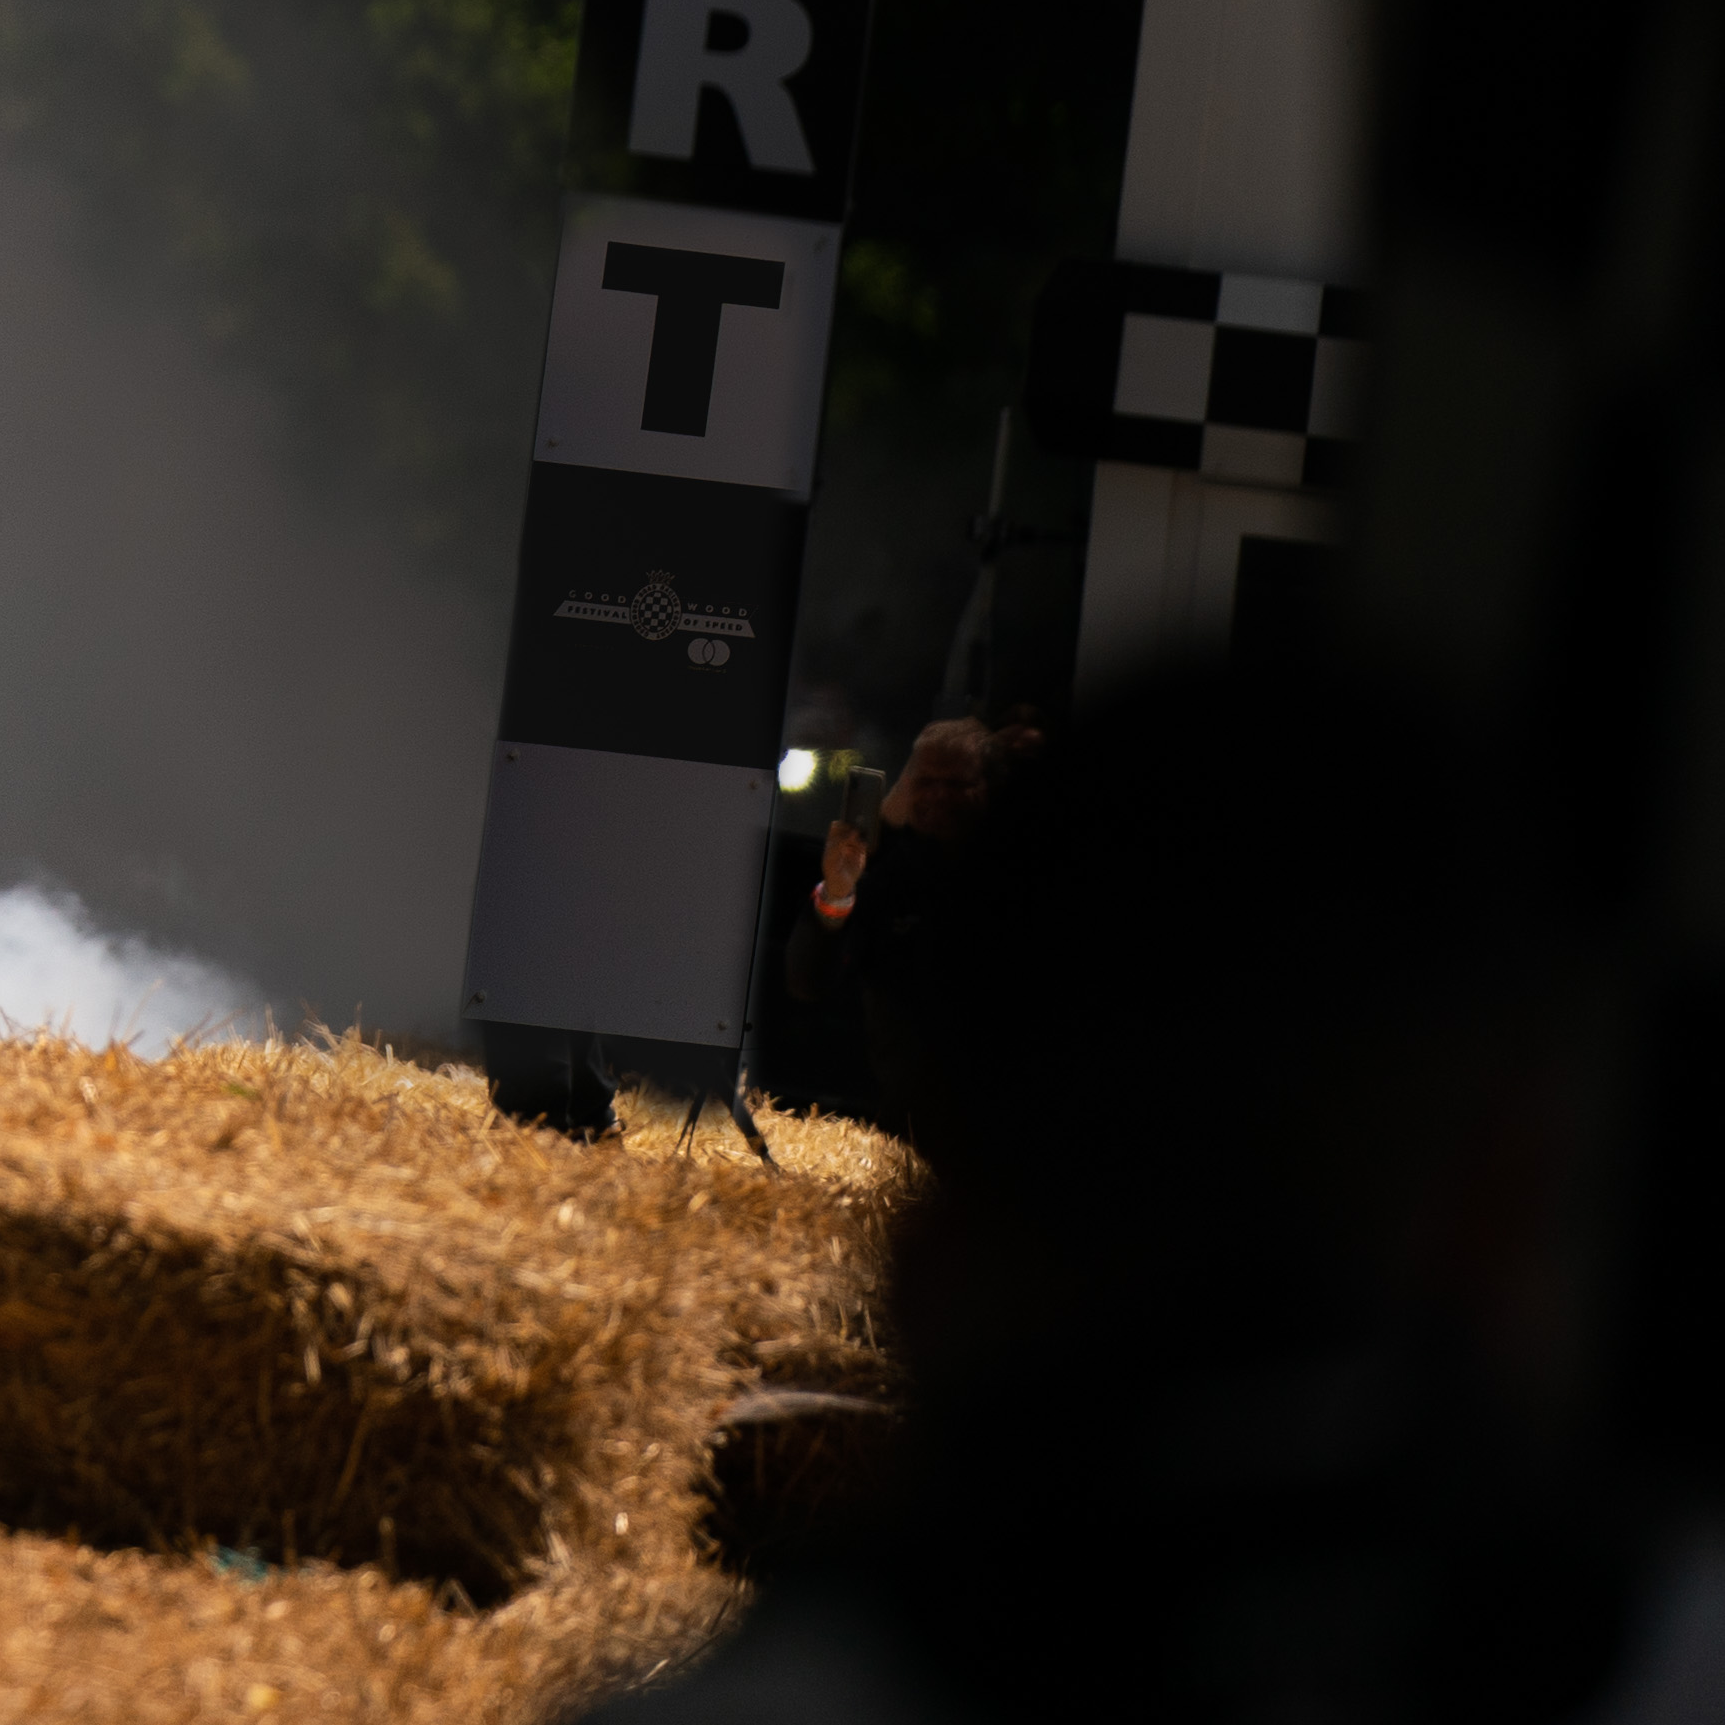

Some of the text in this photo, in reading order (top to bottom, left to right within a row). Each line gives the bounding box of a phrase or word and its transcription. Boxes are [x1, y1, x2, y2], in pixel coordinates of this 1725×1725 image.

[567, 605, 743, 632] FESTIVAL OF SPEED
